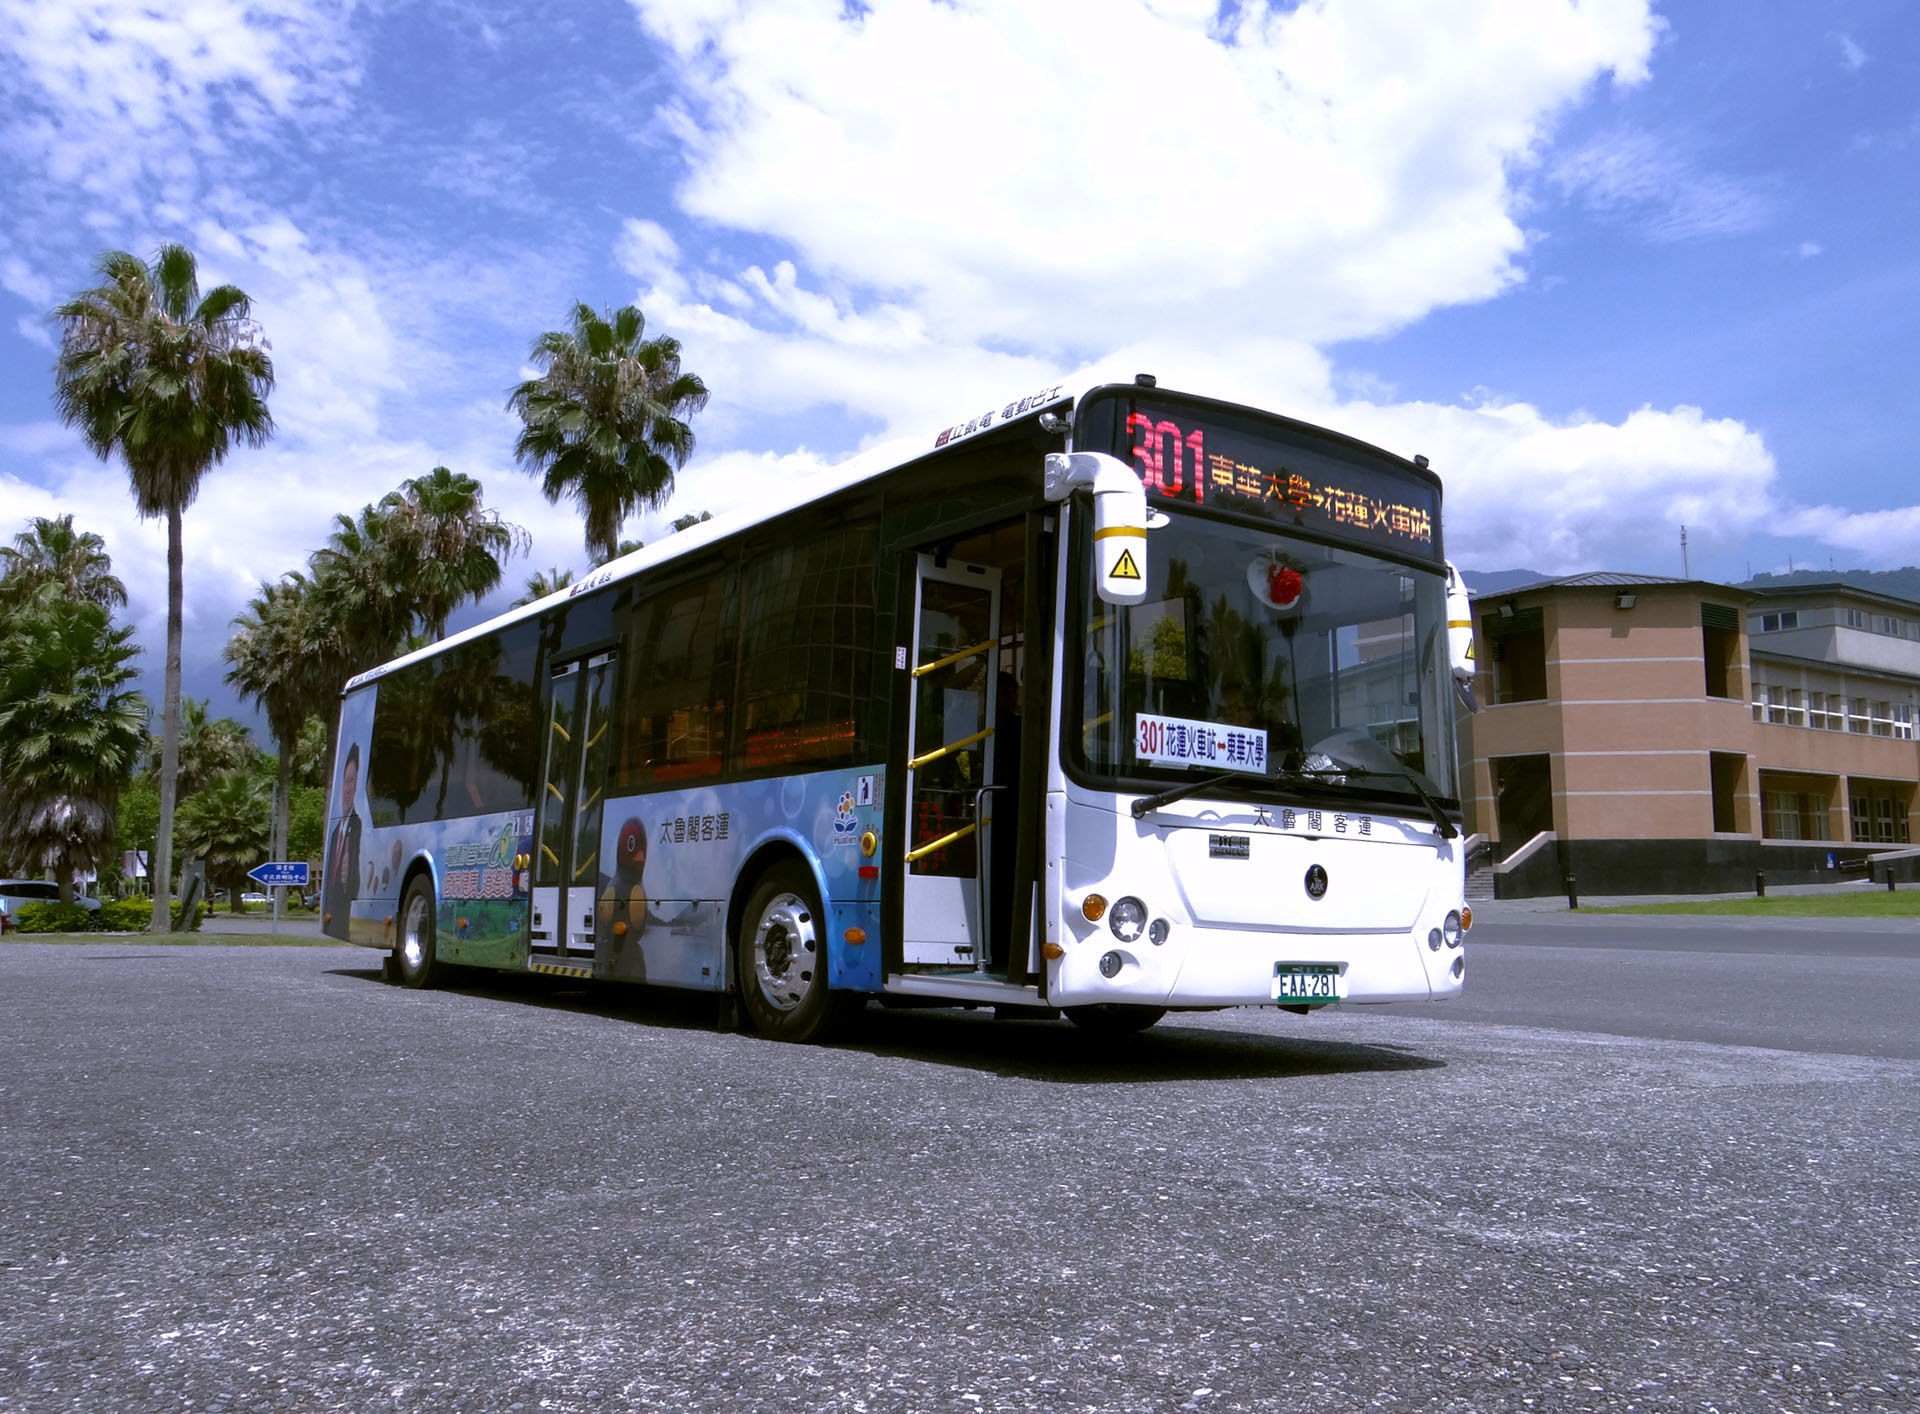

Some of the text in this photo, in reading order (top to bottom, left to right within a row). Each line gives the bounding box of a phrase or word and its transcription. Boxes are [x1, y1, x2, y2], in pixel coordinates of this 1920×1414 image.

[1126, 413, 1203, 504] 301
[1209, 454, 1432, 543] 東華大學 花蓮火車站
[1140, 719, 1264, 767] 301 花蓮火車站 東華大學
[659, 813, 730, 845] 太魯閣客運
[1254, 806, 1372, 836] 太魯閣客運
